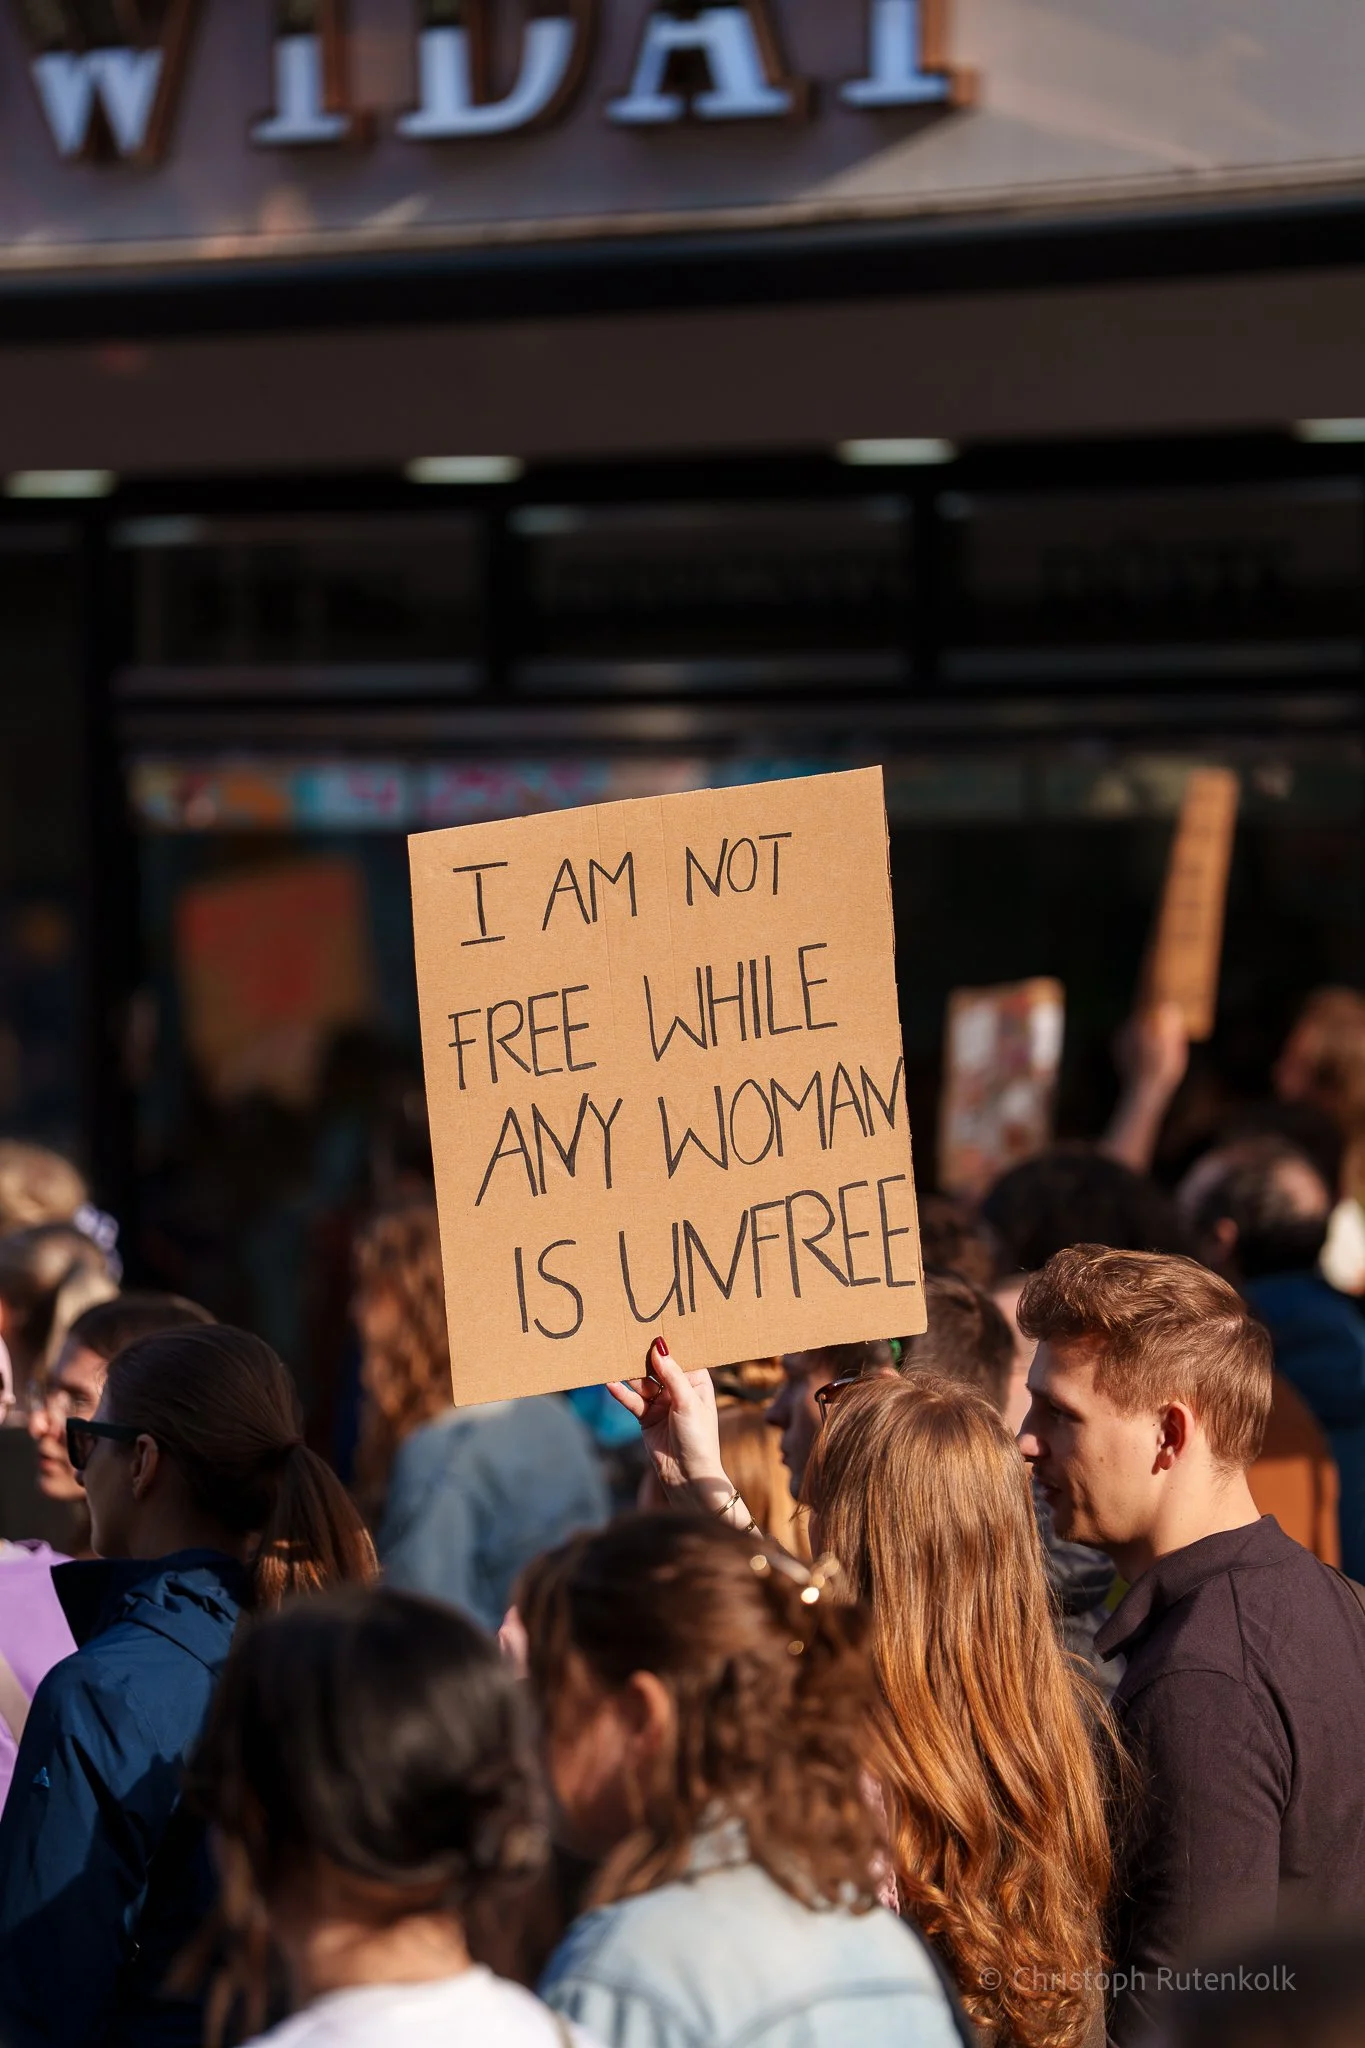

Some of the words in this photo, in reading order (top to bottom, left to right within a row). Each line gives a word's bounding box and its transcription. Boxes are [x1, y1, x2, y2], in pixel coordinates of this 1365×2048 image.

[453, 861, 508, 947] I
[542, 851, 638, 931] AM
[685, 832, 792, 907] NOT
[448, 984, 597, 1091] FREE
[643, 942, 838, 1062] WHILE
[475, 1092, 624, 1207] ANY
[658, 1056, 904, 1180] WOMAN
[514, 1238, 585, 1340] IS
[618, 1173, 917, 1323] UNFREE
